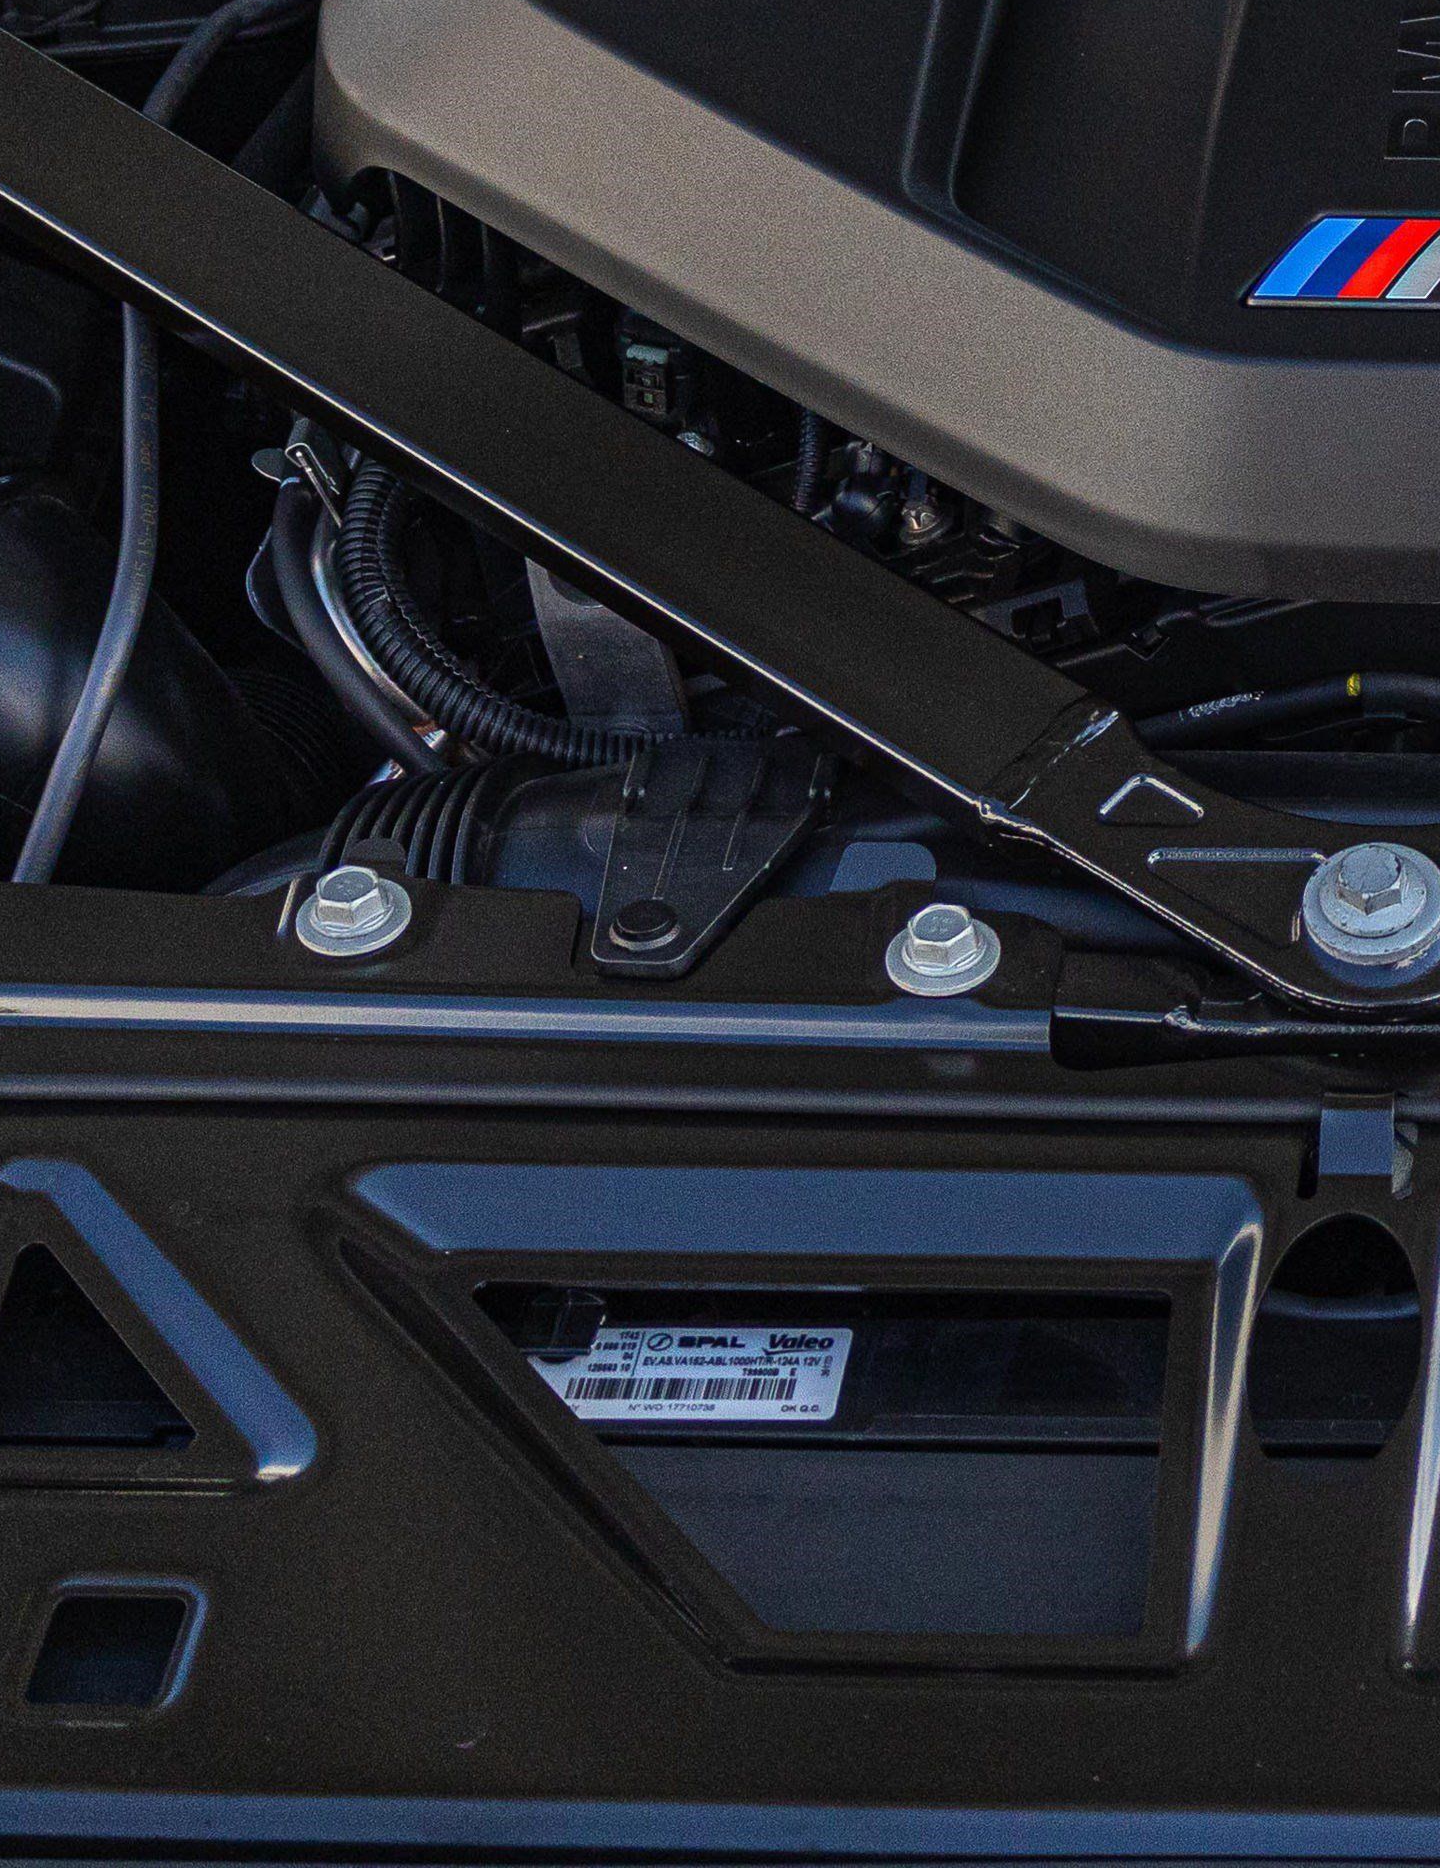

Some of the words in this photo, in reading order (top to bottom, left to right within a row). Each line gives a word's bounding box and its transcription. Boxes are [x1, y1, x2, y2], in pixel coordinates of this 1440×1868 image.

[677, 1335, 745, 1349] SPAL
[768, 1334, 835, 1351] Valeo
[803, 1356, 821, 1366] 12V
